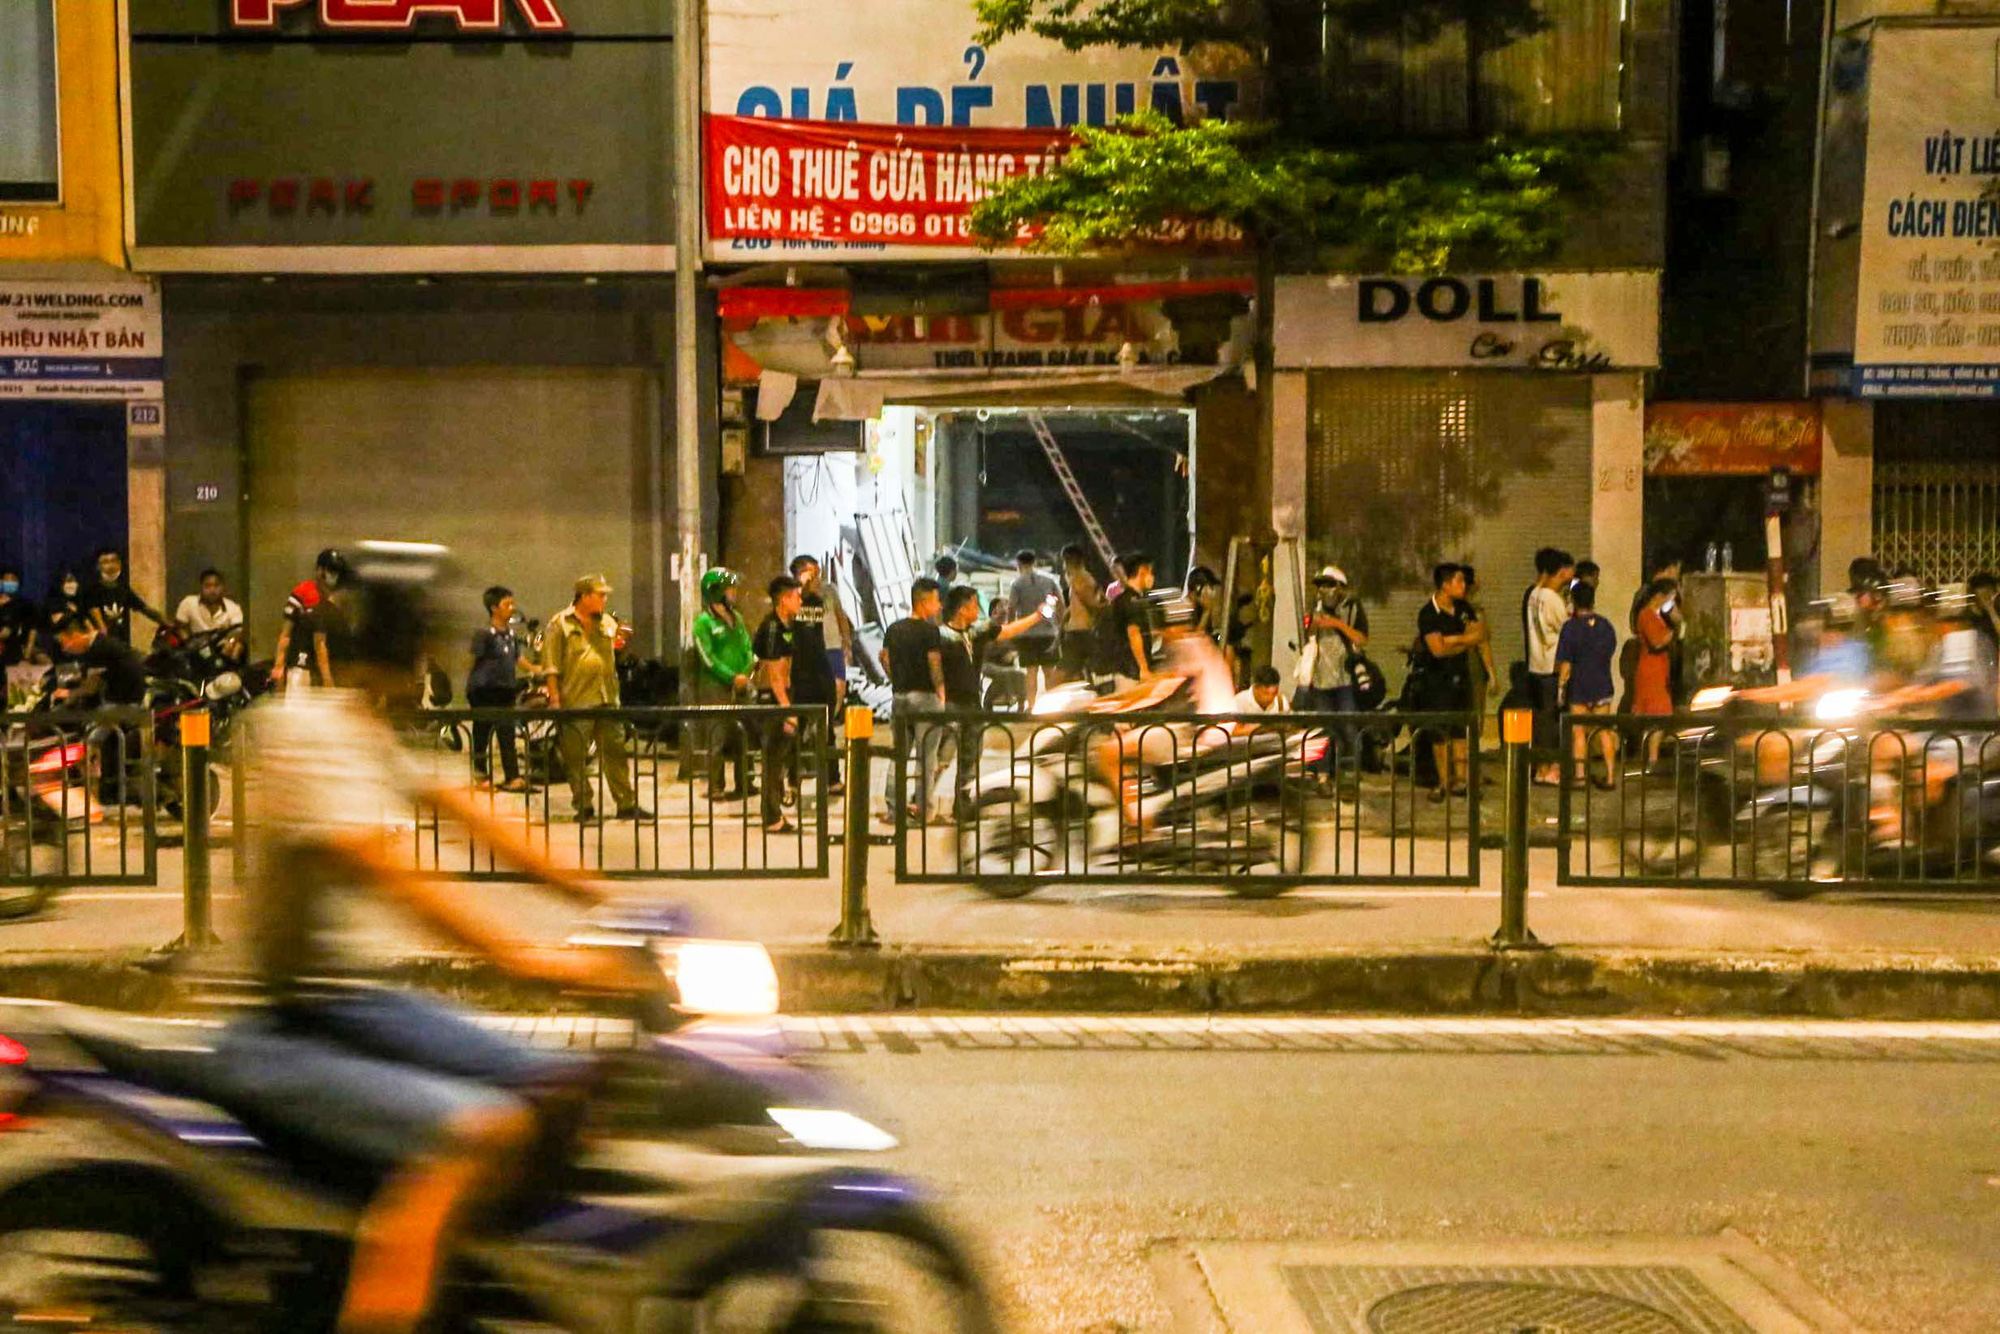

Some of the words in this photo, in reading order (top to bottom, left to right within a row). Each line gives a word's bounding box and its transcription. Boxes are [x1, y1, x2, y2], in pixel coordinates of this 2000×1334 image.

[724, 145, 780, 197] CHO
[789, 140, 859, 200] THUÊ
[870, 133, 926, 201] CỬA
[724, 203, 781, 231] LIÊN
[790, 206, 824, 238] HỆ
[850, 212, 916, 236] 0966
[1887, 192, 1947, 237] CÁCH
[1358, 276, 1562, 323] DOLL
[49, 326, 100, 351] NHẬT
[105, 326, 145, 348] BẢN
[133, 408, 157, 423] 212
[196, 486, 219, 500] 210
